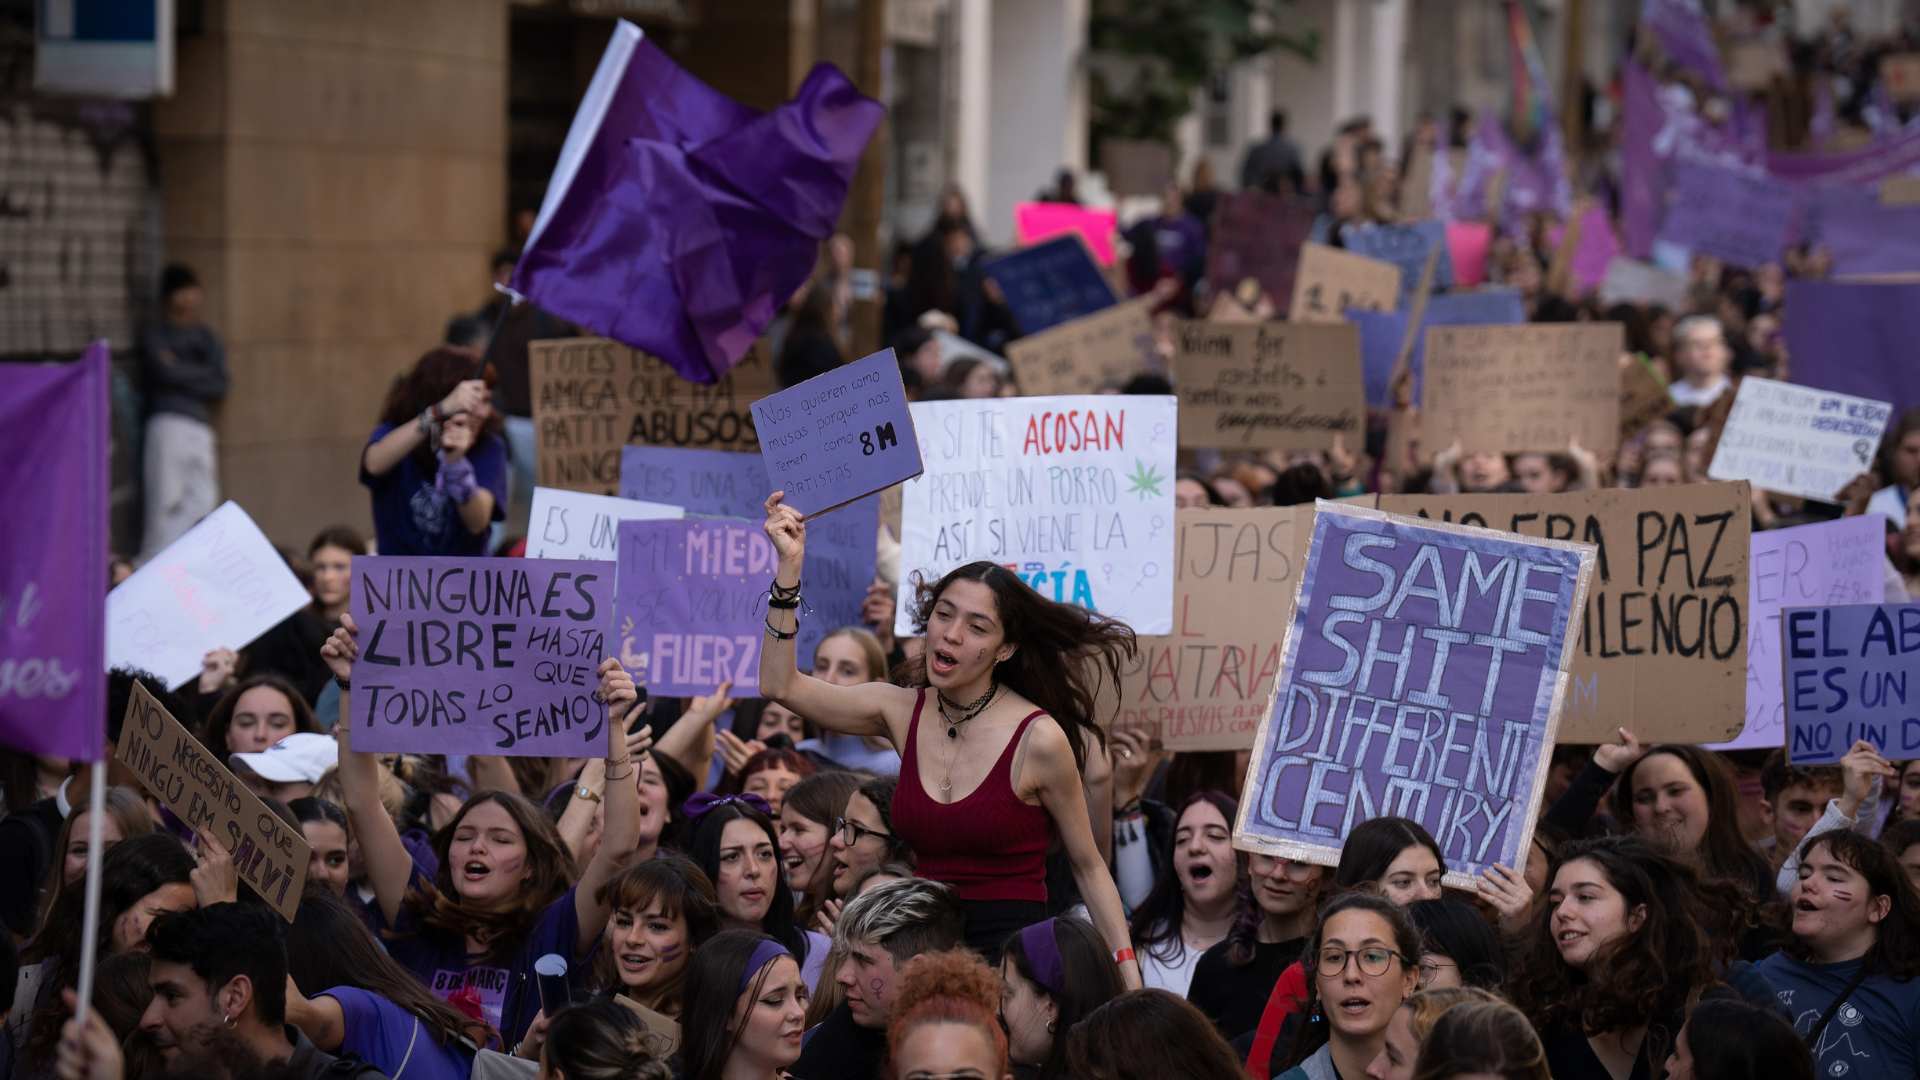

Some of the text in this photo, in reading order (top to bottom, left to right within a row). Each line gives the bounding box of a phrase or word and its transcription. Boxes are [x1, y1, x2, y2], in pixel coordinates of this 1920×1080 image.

[538, 346, 616, 373] TOTES
[540, 379, 619, 410] AMIGA
[628, 375, 680, 407] QUE
[759, 402, 792, 426] Nos
[801, 383, 849, 416] quieren
[542, 409, 758, 449] PATIT ABUSOS
[768, 391, 890, 451] musas porque nos
[823, 432, 854, 452] como
[860, 421, 898, 457] 8M
[943, 409, 1125, 460] SI TE ACOSAN
[929, 465, 1117, 514] PRENDE UN PORRO
[543, 505, 570, 546] ES
[933, 511, 1128, 562] ASÍ SI VIENE LA
[1636, 510, 1737, 592] PAZ
[632, 527, 669, 577] MI
[363, 567, 598, 621] NINGUNA ES
[1328, 532, 1565, 647] SAME
[362, 619, 605, 672] LIBRE HASTA
[1578, 591, 1741, 662] ILENCIO
[1790, 608, 1849, 659] EL
[534, 661, 590, 687] QUE
[651, 633, 761, 687] FUERZ
[1300, 610, 1531, 718] SHIT
[361, 683, 513, 728] TODAS LO
[1794, 667, 1849, 714] ES
[1860, 670, 1907, 709] UN
[131, 692, 164, 741] NO
[492, 689, 605, 748] SEAMOS
[1275, 682, 1531, 800] DIFFERENT
[1792, 722, 1832, 753] NO
[1846, 721, 1887, 753] UN
[124, 732, 185, 804] NINGÚ
[1259, 755, 1514, 865] CENTURY
[435, 972, 447, 990] 8
